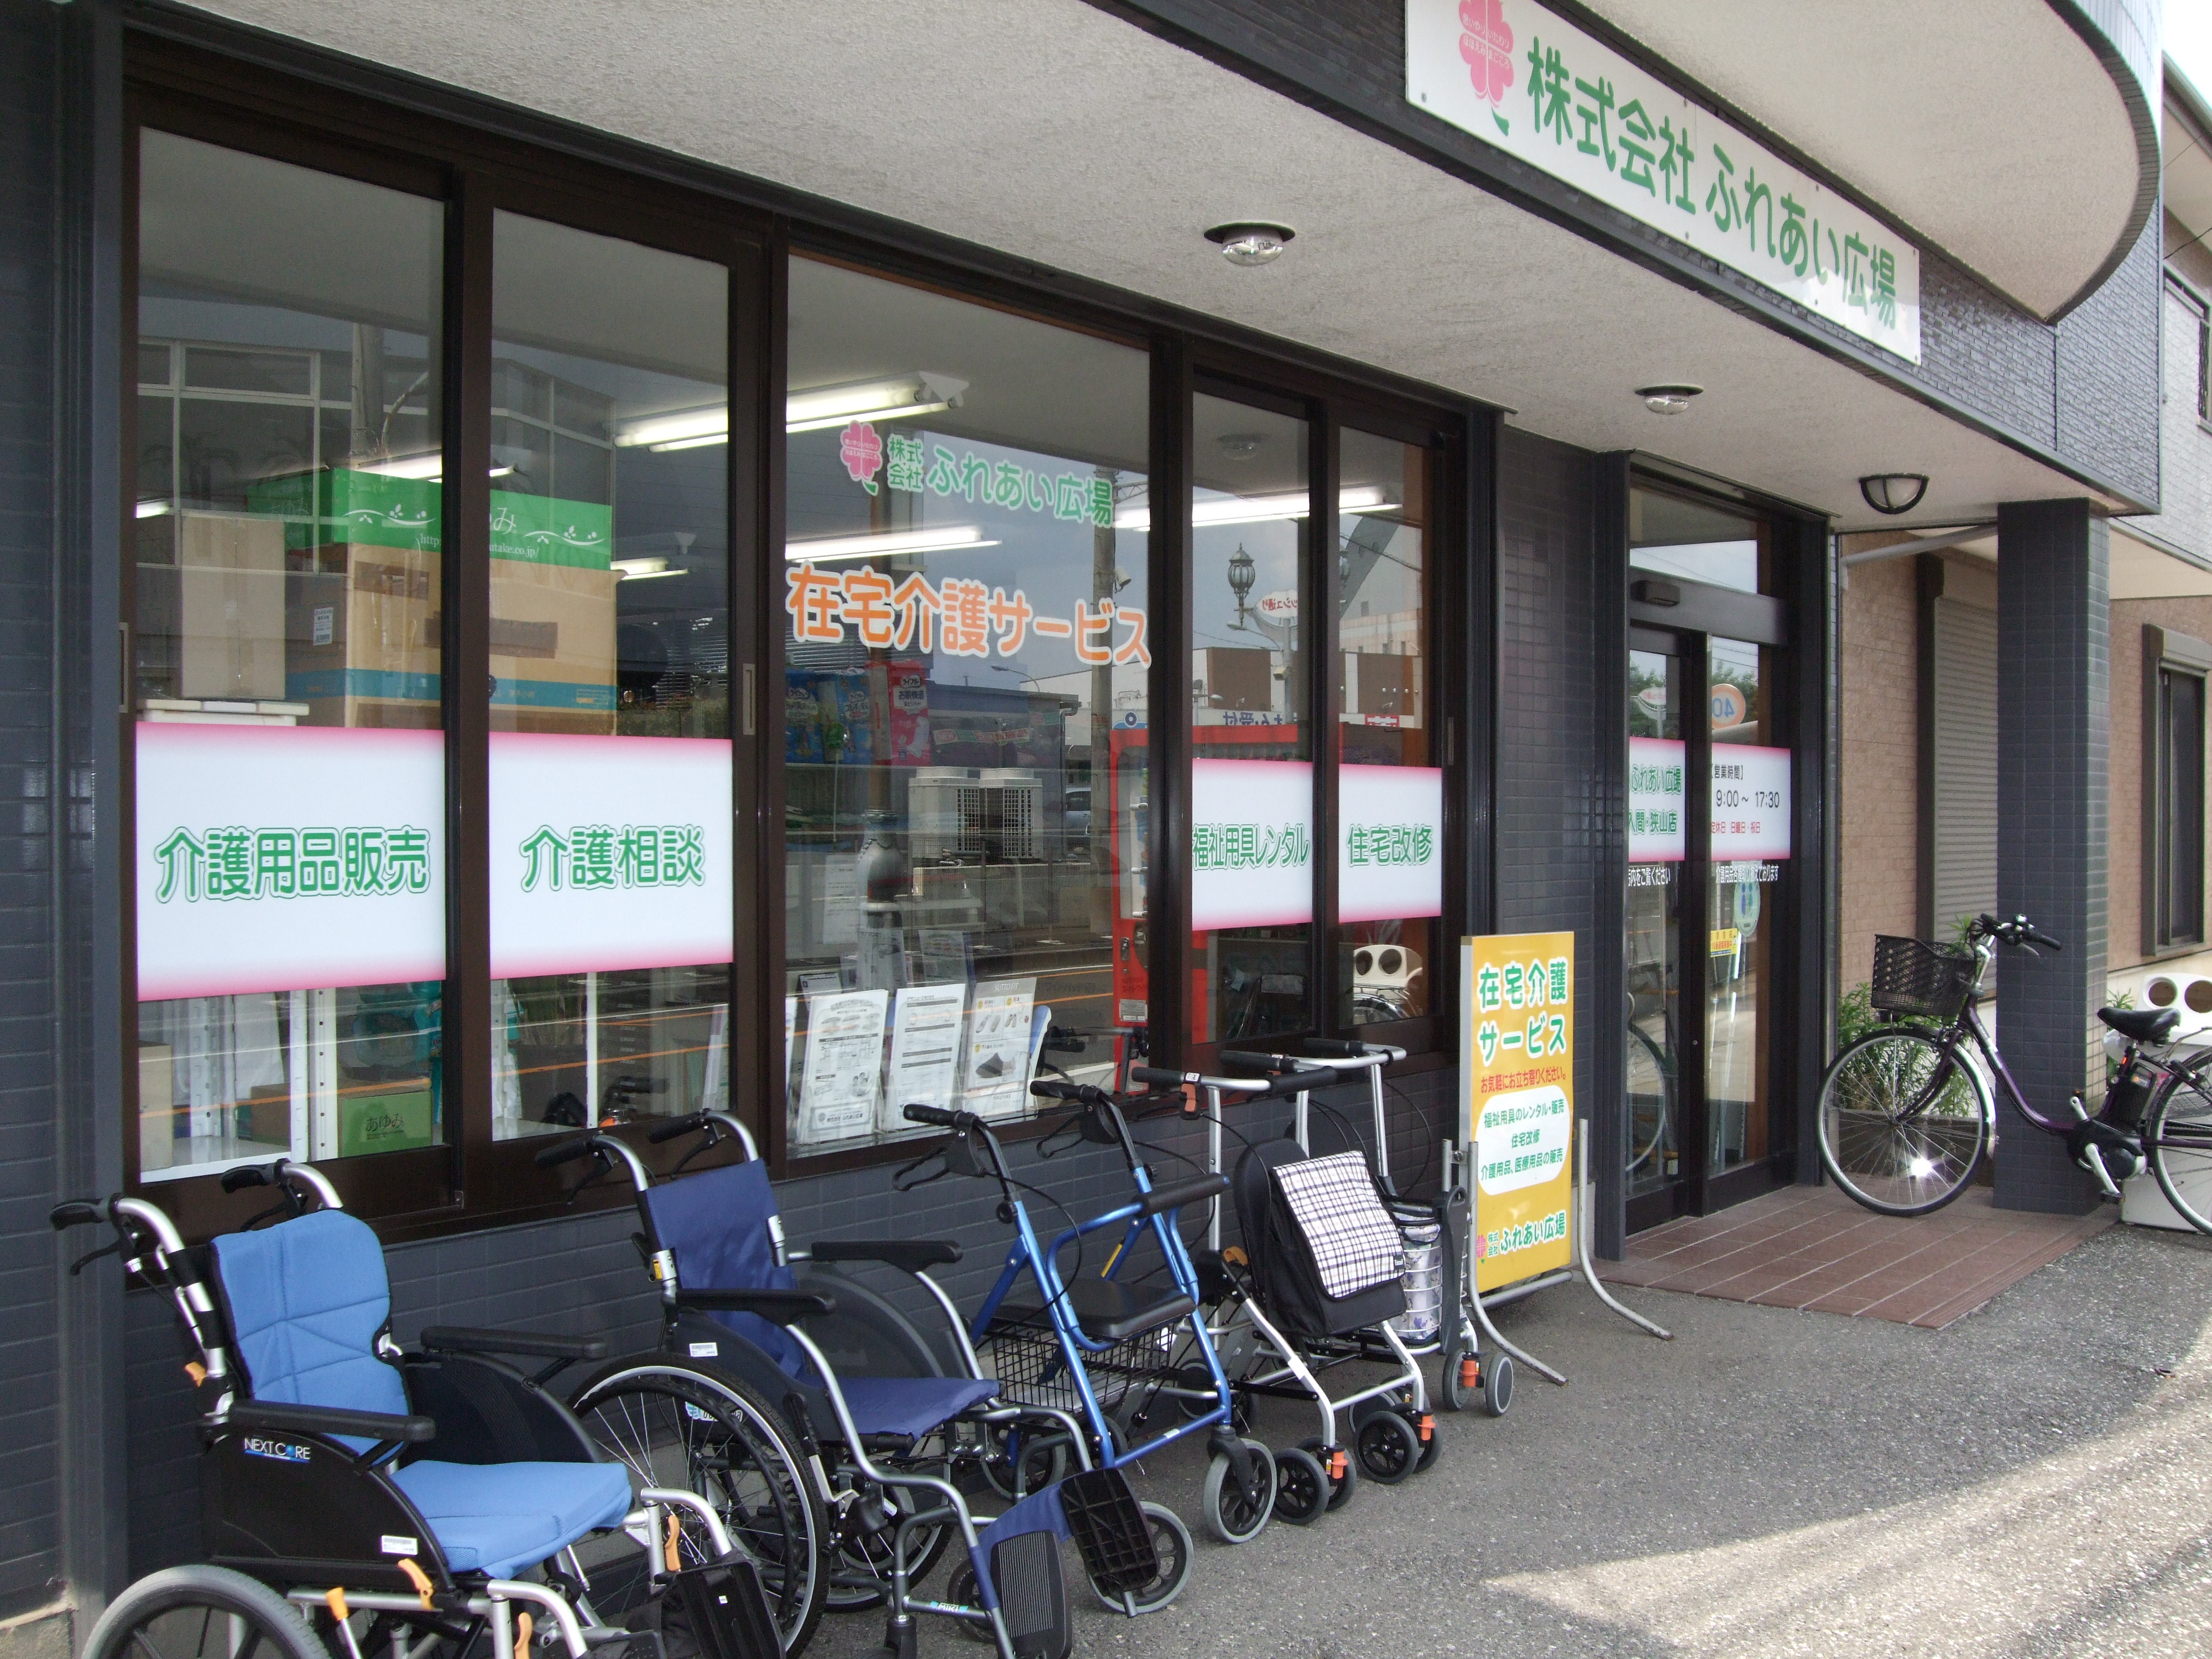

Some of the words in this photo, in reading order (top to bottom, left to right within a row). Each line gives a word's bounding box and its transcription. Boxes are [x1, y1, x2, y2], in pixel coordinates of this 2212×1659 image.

[1527, 36, 1695, 215] 株式会社
[1706, 144, 1897, 331] ふれあい広場
[927, 445, 1113, 526] ふれあい広場
[787, 563, 1150, 666] 在宅介護サービス
[1631, 764, 1681, 795] ふれあい広場
[1755, 791, 1780, 808] 17:30
[155, 825, 430, 904] 介護用品販売
[519, 824, 706, 893] 介護相談
[1193, 823, 1310, 870] 福祉用具レンタル
[1347, 824, 1433, 867] 住宅改修
[1479, 961, 1566, 1009] 在宅介護
[1479, 1015, 1565, 1062] サービス
[1481, 1066, 1566, 1093] お気軽にお立ち寄りください。
[366, 1113, 404, 1131] あゆみ
[1484, 1099, 1564, 1128] 福祉用具のレンタル・販売
[1511, 1129, 1540, 1149] 住宅改修
[1481, 1147, 1563, 1181] 介護用品、医療用品の販売
[1500, 1212, 1566, 1252] ふれあい広場
[244, 1437, 273, 1454] NEXT
